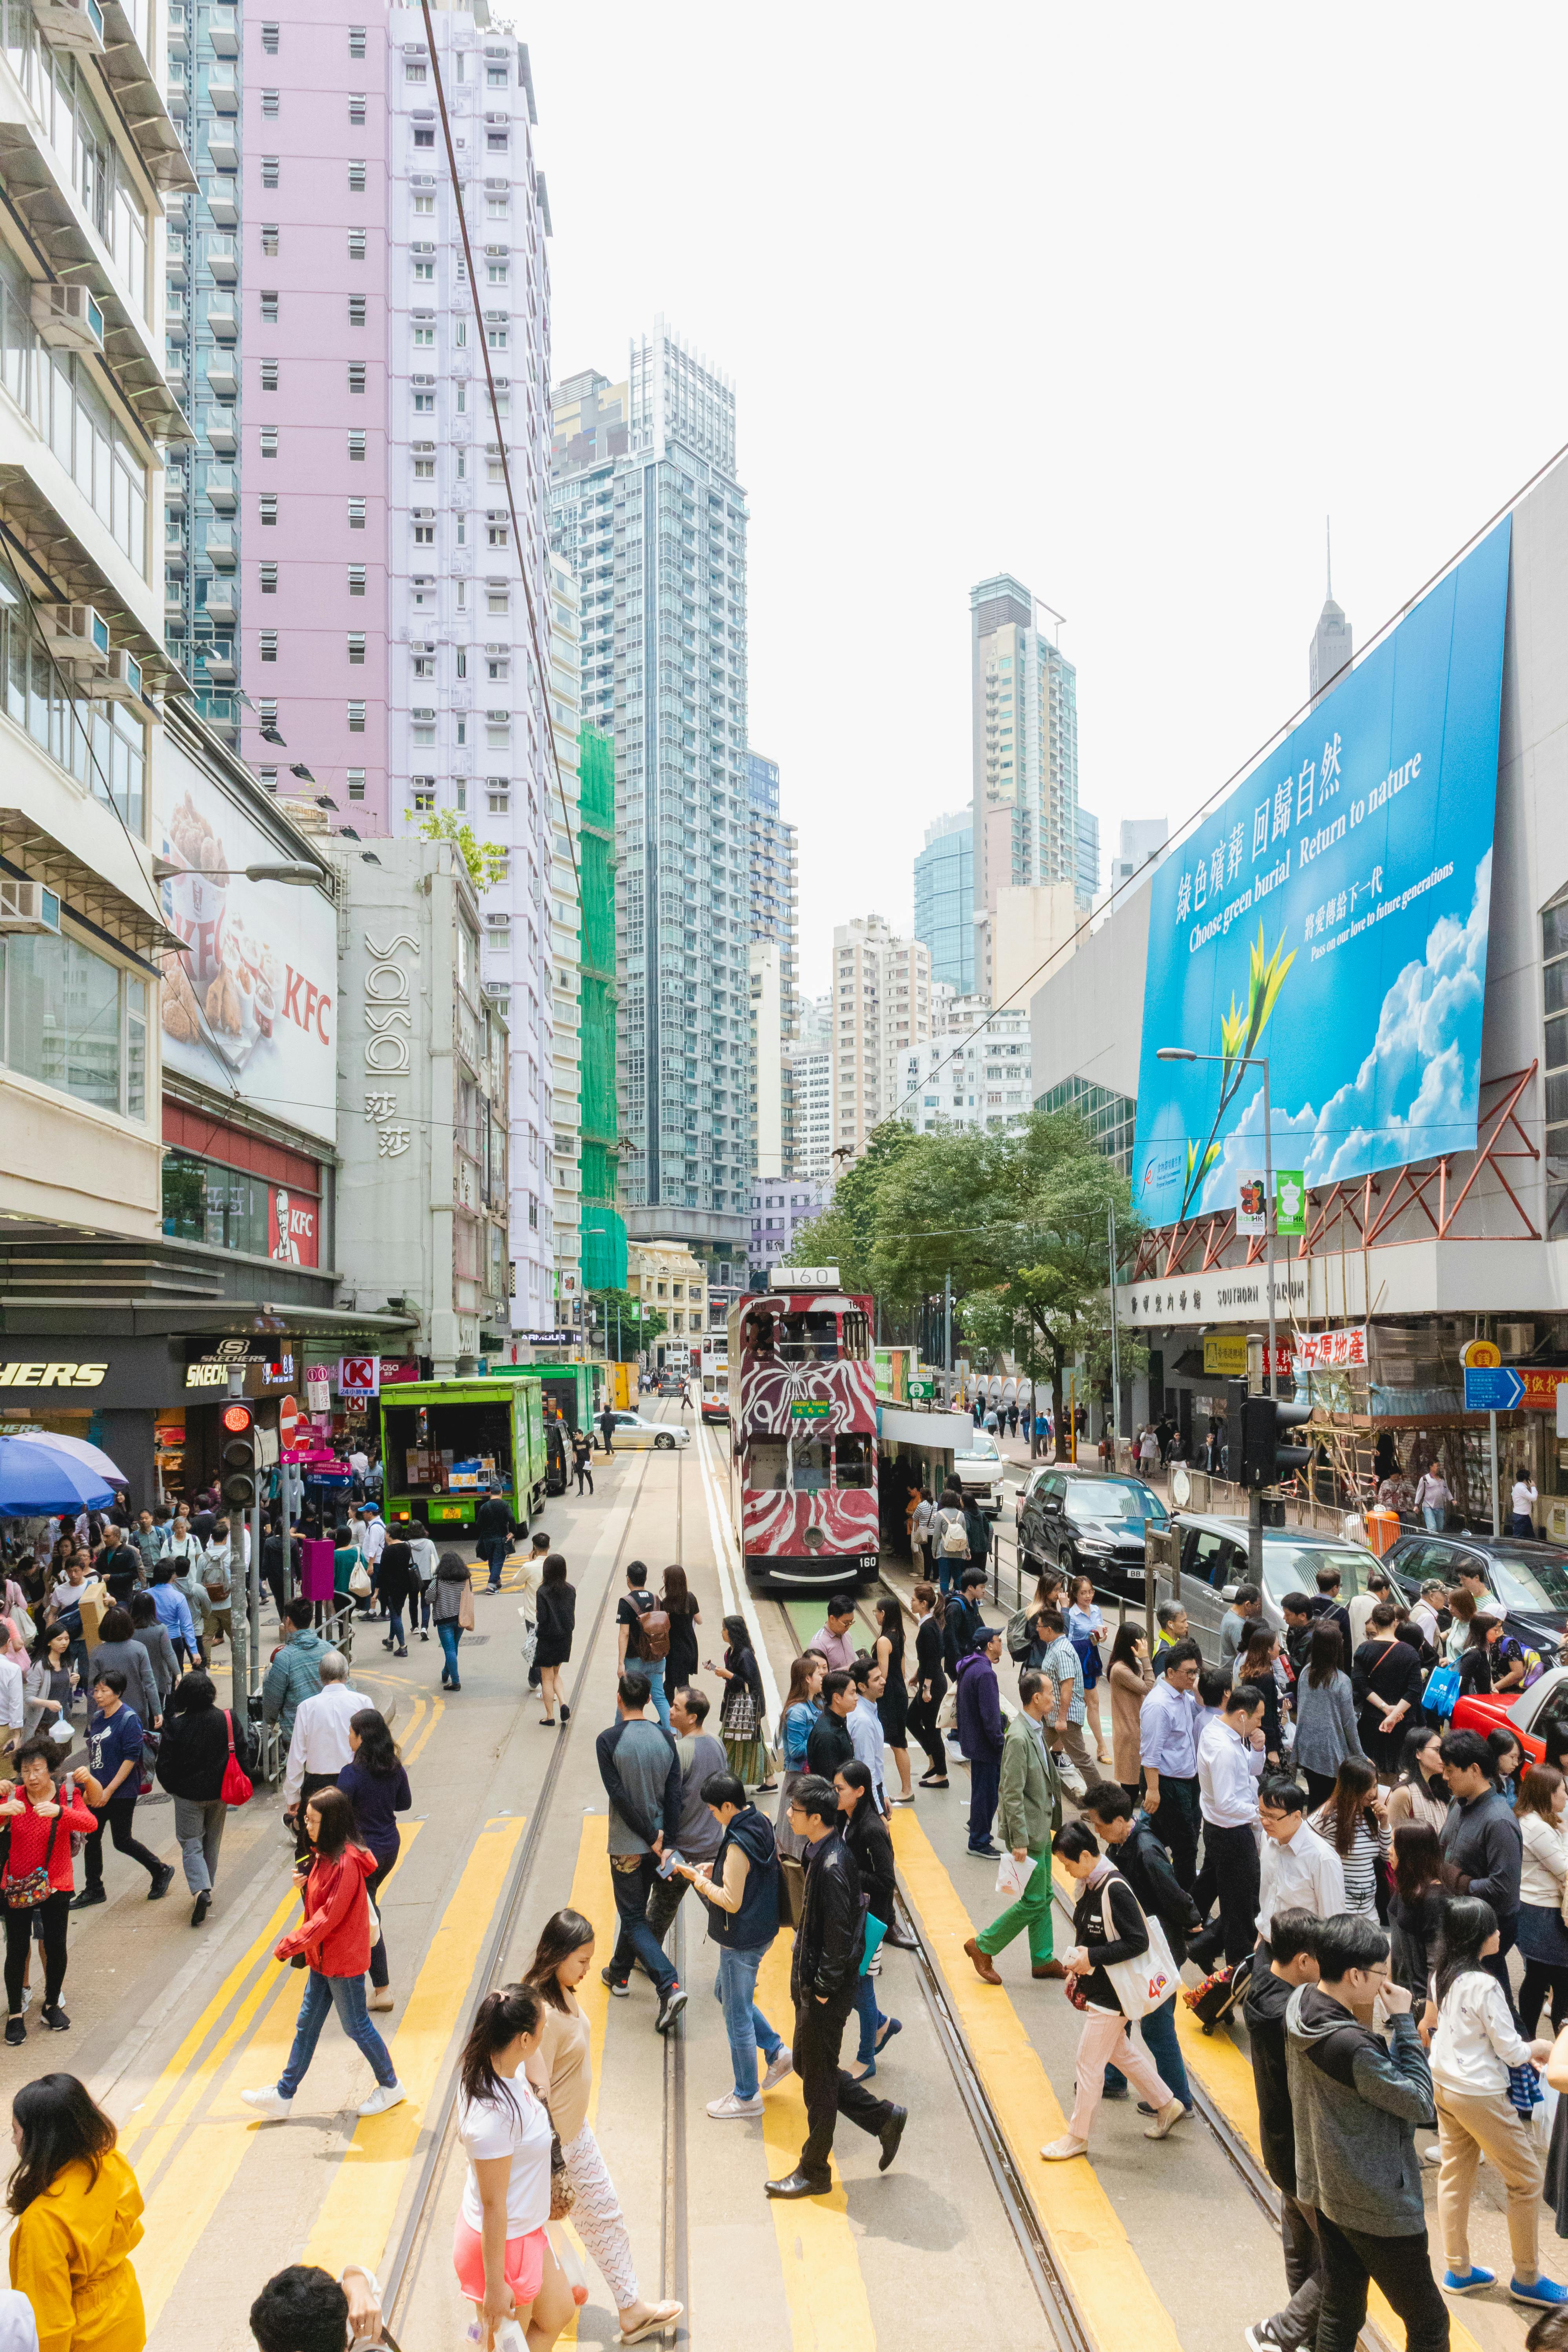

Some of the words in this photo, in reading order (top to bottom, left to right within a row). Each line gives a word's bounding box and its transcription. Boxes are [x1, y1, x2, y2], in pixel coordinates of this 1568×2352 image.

[1252, 732, 1342, 863] 回歸自然
[1189, 916, 1223, 953] Choose
[1223, 888, 1252, 935] green
[1254, 849, 1290, 902] burial
[1299, 814, 1346, 868] Return
[1350, 799, 1364, 829] to
[1368, 752, 1421, 815] nature
[1304, 866, 1383, 942] 將愛傳給下一代
[1310, 943, 1326, 962] Pass
[1327, 937, 1336, 952] on
[1337, 928, 1350, 946] our
[1350, 918, 1366, 938] love
[1367, 911, 1375, 927] to
[1376, 895, 1401, 922] future
[1401, 861, 1454, 910] generations
[281, 963, 331, 1046] KFC
[364, 1091, 411, 1158] 莎莎
[290, 1209, 314, 1238] KFC
[791, 1269, 828, 1284] 160
[1218, 1285, 1258, 1306] SOUTHORN
[848, 1301, 865, 1309] 160
[1304, 1329, 1366, 1368] 中原地產
[0, 1363, 108, 1387] HERS
[859, 1557, 876, 1568] 160
